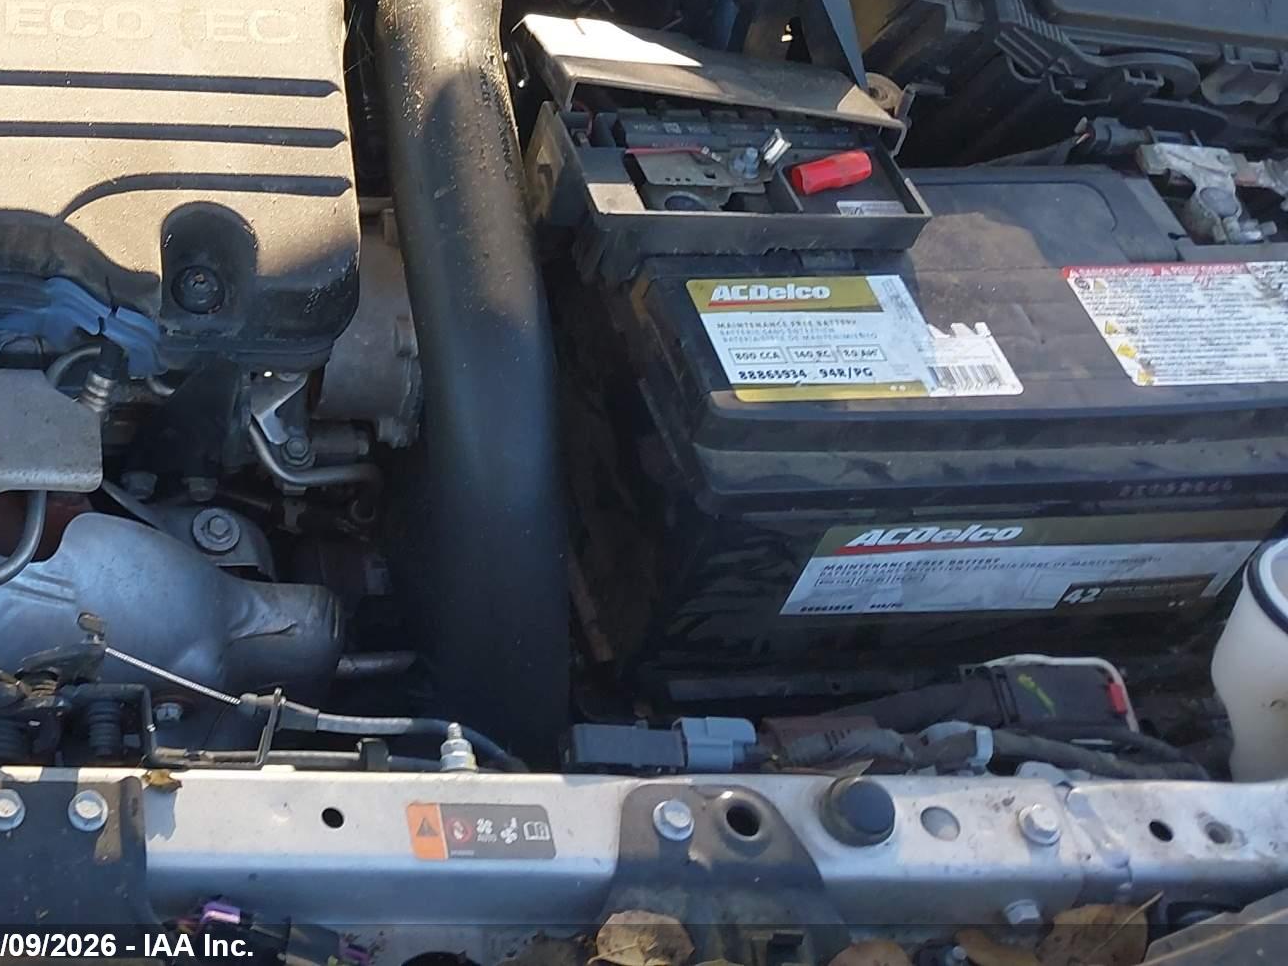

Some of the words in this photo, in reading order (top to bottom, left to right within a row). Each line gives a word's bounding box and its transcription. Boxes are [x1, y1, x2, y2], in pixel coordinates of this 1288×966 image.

[710, 284, 831, 302] ACDelco
[845, 524, 1024, 548] ACDelco
[1063, 587, 1103, 604] 42
